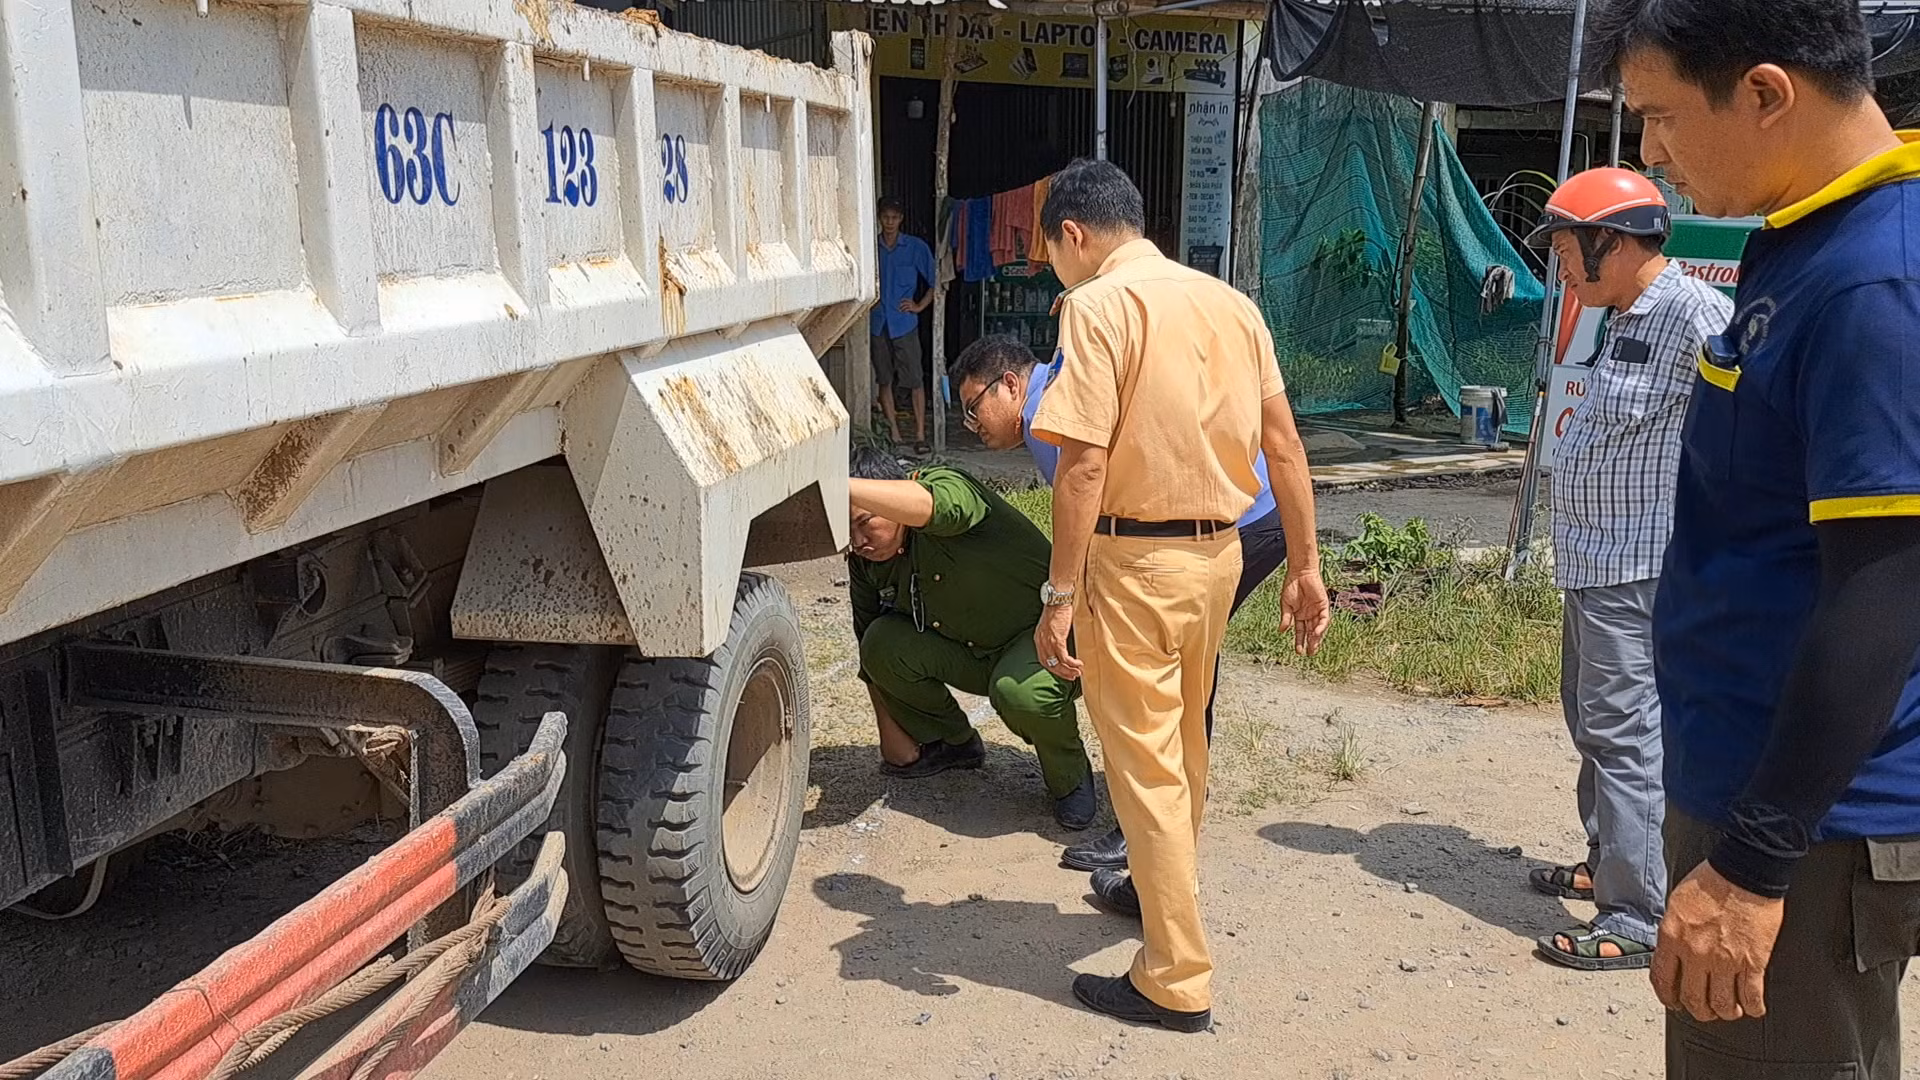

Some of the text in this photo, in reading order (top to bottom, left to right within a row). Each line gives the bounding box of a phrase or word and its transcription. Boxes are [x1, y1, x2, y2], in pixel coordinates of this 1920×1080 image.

[1020, 20, 1111, 47] LAPTO
[1134, 28, 1227, 55] CAMERA
[1189, 101, 1229, 116] nhận in
[374, 102, 688, 207] 63C 123 28
